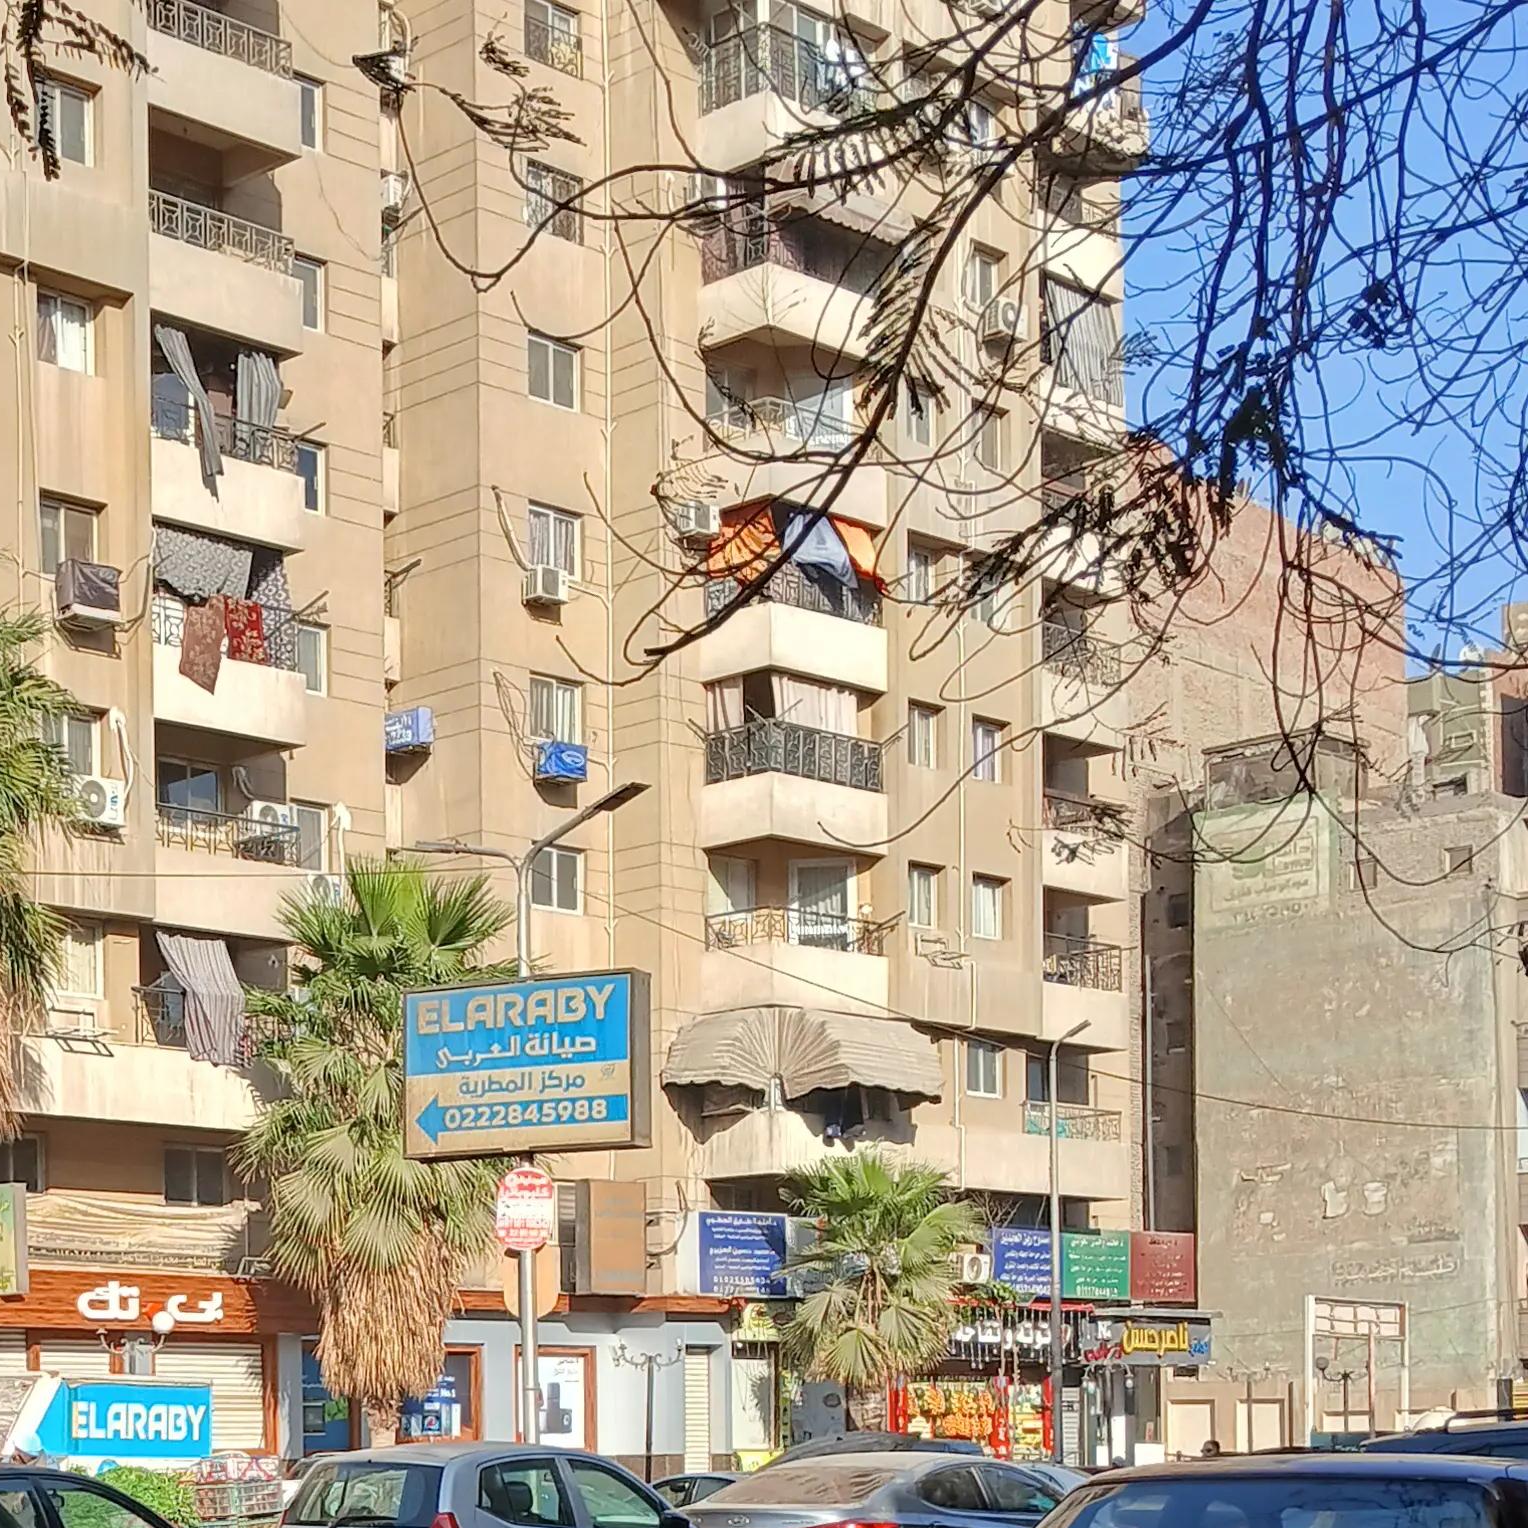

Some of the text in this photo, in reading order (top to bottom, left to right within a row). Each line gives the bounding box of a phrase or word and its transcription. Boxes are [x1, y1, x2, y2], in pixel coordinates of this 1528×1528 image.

[416, 984, 616, 1035] ELARABY
[525, 1032, 597, 1059] صيانة
[458, 1070, 585, 1098] مركز المطرية
[444, 1099, 608, 1129] 0222845988
[72, 1401, 206, 1441] ELARABY
